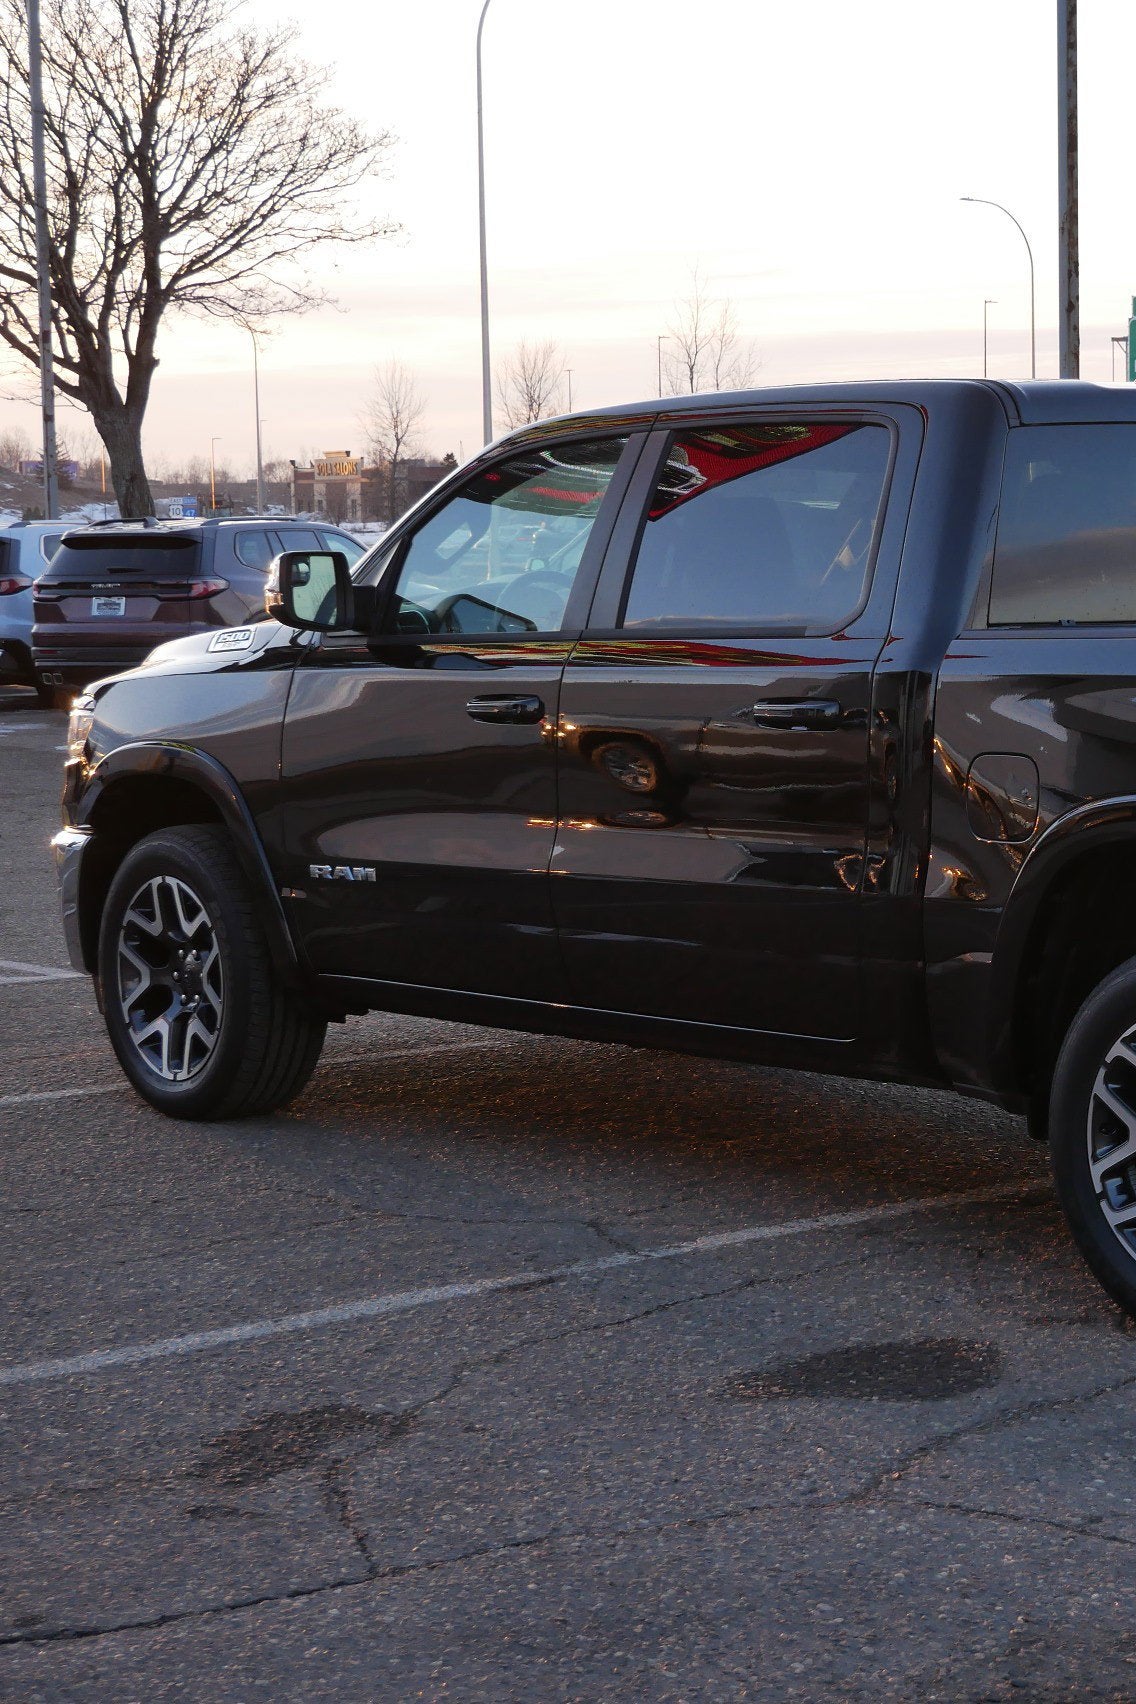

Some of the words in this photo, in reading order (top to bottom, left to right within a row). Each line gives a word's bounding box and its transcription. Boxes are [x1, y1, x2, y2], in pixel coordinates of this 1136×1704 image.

[335, 462, 358, 475] SALONS
[172, 507, 181, 516] 10
[185, 509, 196, 517] 47
[309, 864, 377, 882] RAM
